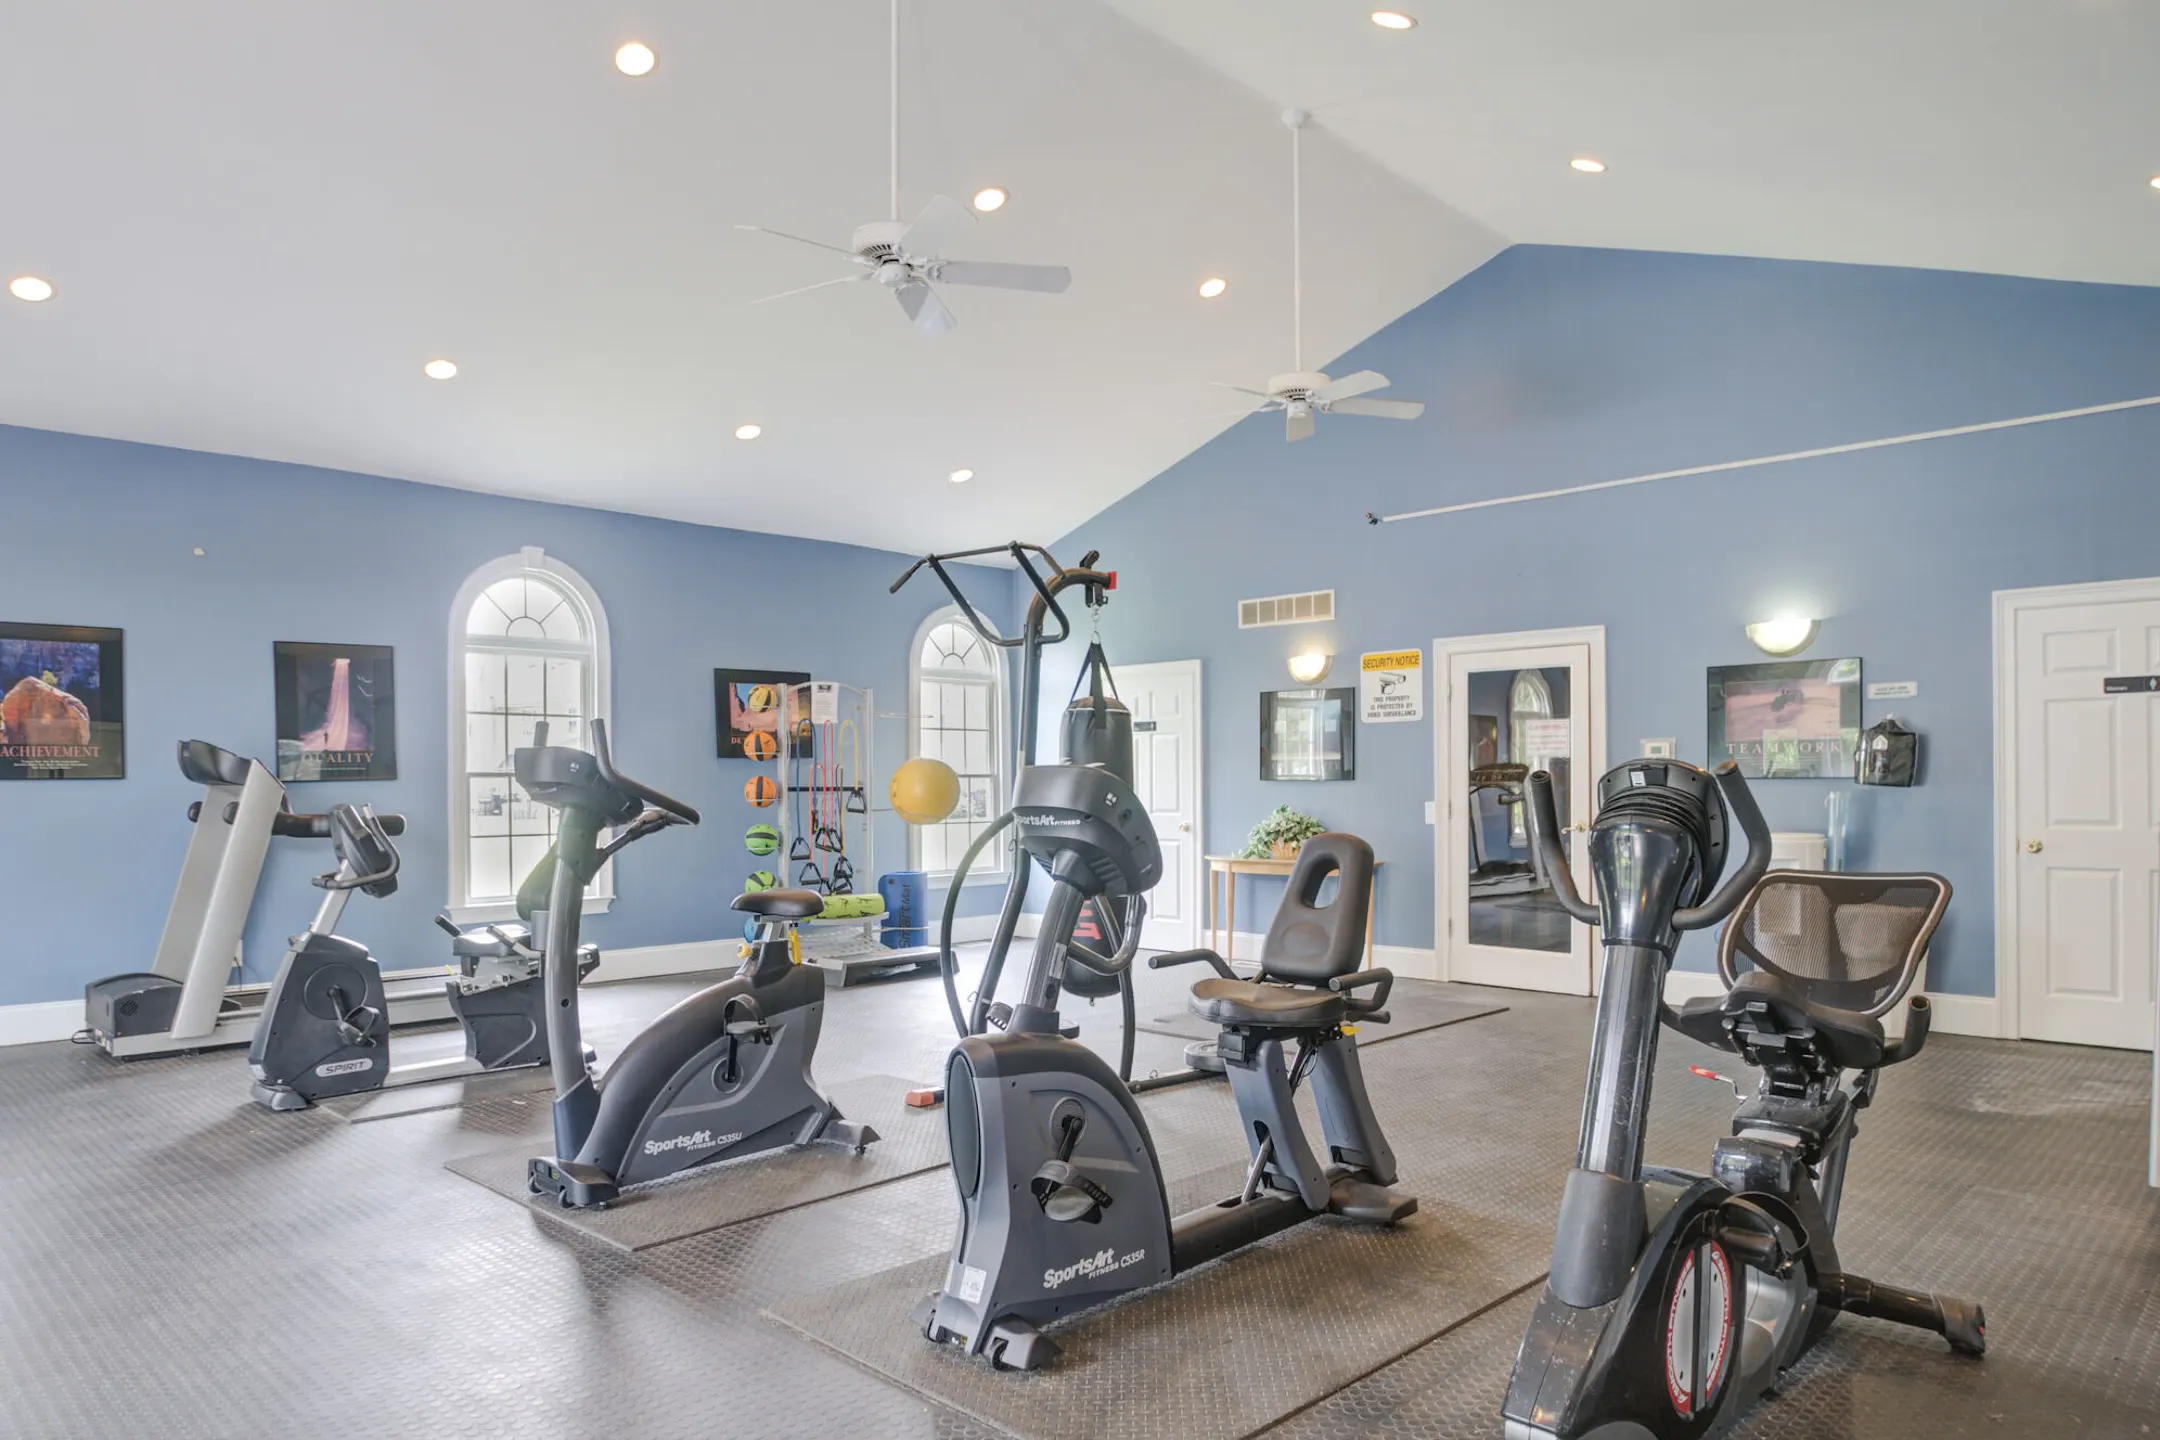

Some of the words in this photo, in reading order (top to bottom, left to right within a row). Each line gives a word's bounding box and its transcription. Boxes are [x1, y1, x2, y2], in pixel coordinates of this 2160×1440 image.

[1363, 657, 1394, 669] SECURITY
[1395, 654, 1420, 666] NOTICE
[0, 746, 101, 758] ACHIEVEMENT
[1726, 741, 1841, 755] TEAMWORK
[304, 753, 374, 766] QUALITY
[899, 903, 911, 949] Smart
[325, 1061, 366, 1075] SPIRIT
[643, 1129, 712, 1156] SportsArt
[1043, 1247, 1115, 1290] SportsArt
[1088, 1262, 1120, 1280] FITNESS
